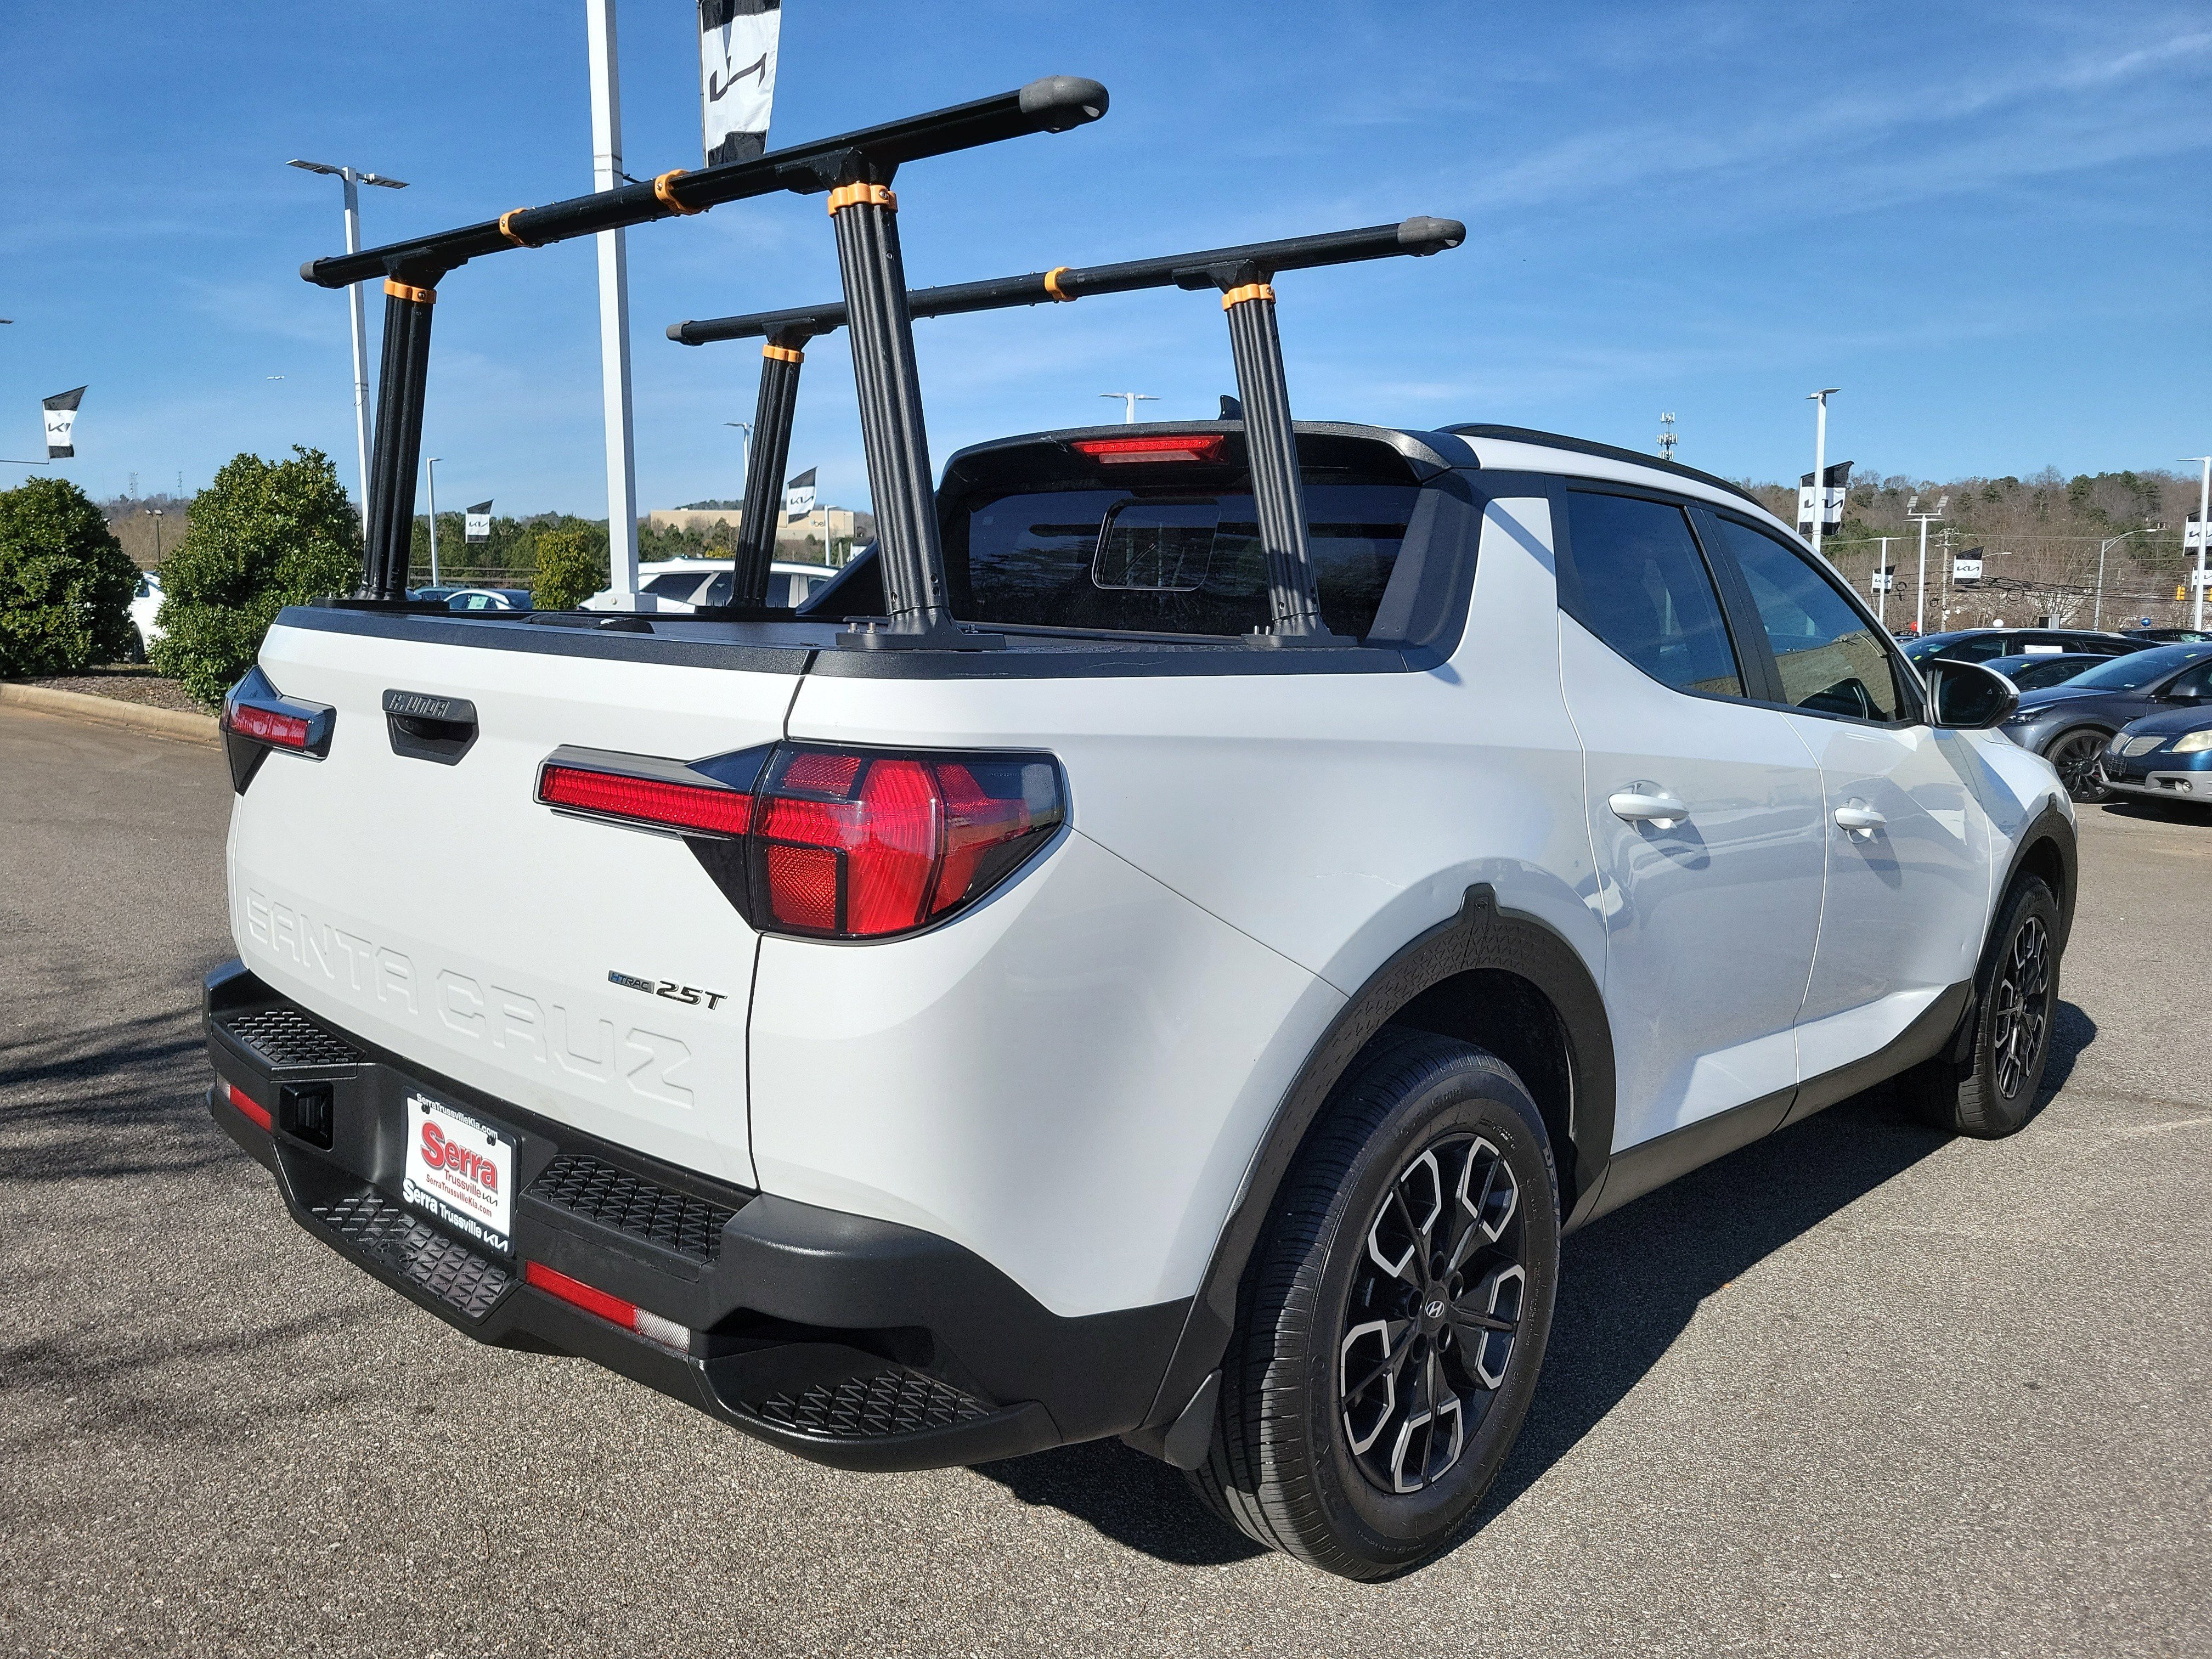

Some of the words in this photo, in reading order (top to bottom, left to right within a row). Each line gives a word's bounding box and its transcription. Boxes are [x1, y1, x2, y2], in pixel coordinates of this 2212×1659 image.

[246, 887, 420, 1016] SANTA
[436, 968, 695, 1109] CRUZ
[610, 972, 650, 991] HTRAC
[416, 1092, 498, 1140] SerraTrussvilleKia.com
[420, 1120, 498, 1194] Serra
[426, 1173, 492, 1218] SerraTrussvilleKia.com
[444, 1169, 481, 1198] Trussville
[402, 1177, 438, 1215] Serra
[439, 1205, 482, 1239] Trussville
[483, 1230, 509, 1253] KIA
